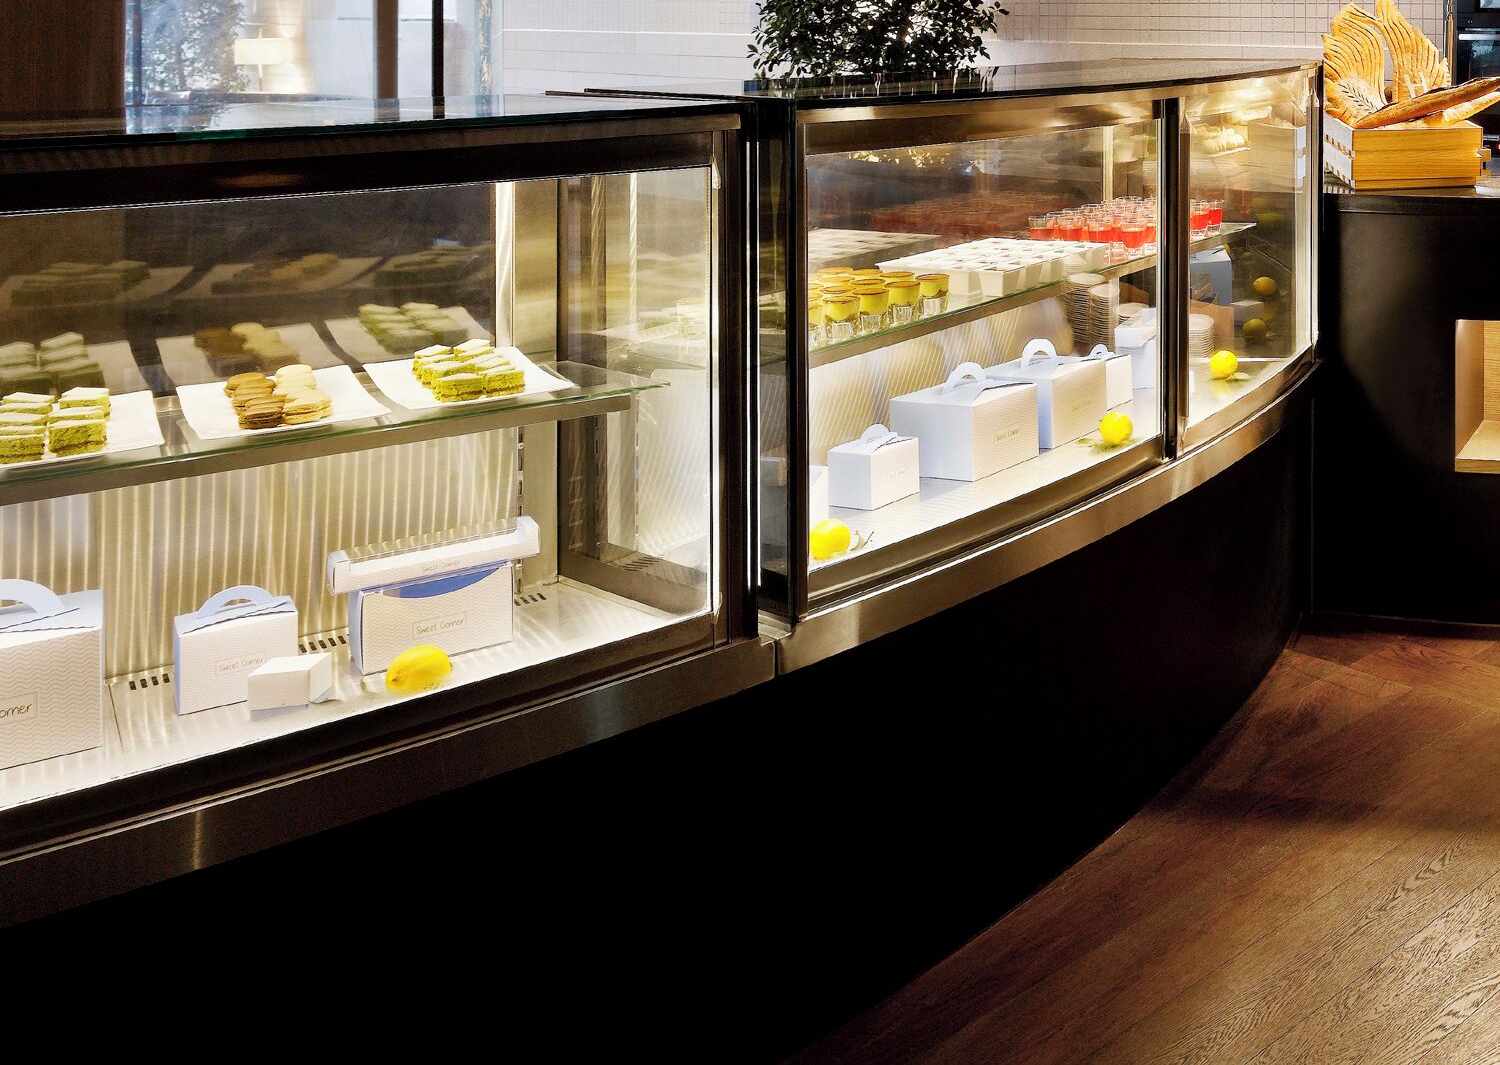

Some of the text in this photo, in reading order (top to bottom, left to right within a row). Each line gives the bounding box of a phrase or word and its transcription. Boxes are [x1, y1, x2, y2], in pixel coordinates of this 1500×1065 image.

[416, 618, 464, 635] Sweet Corner
[0, 703, 33, 719] orner
